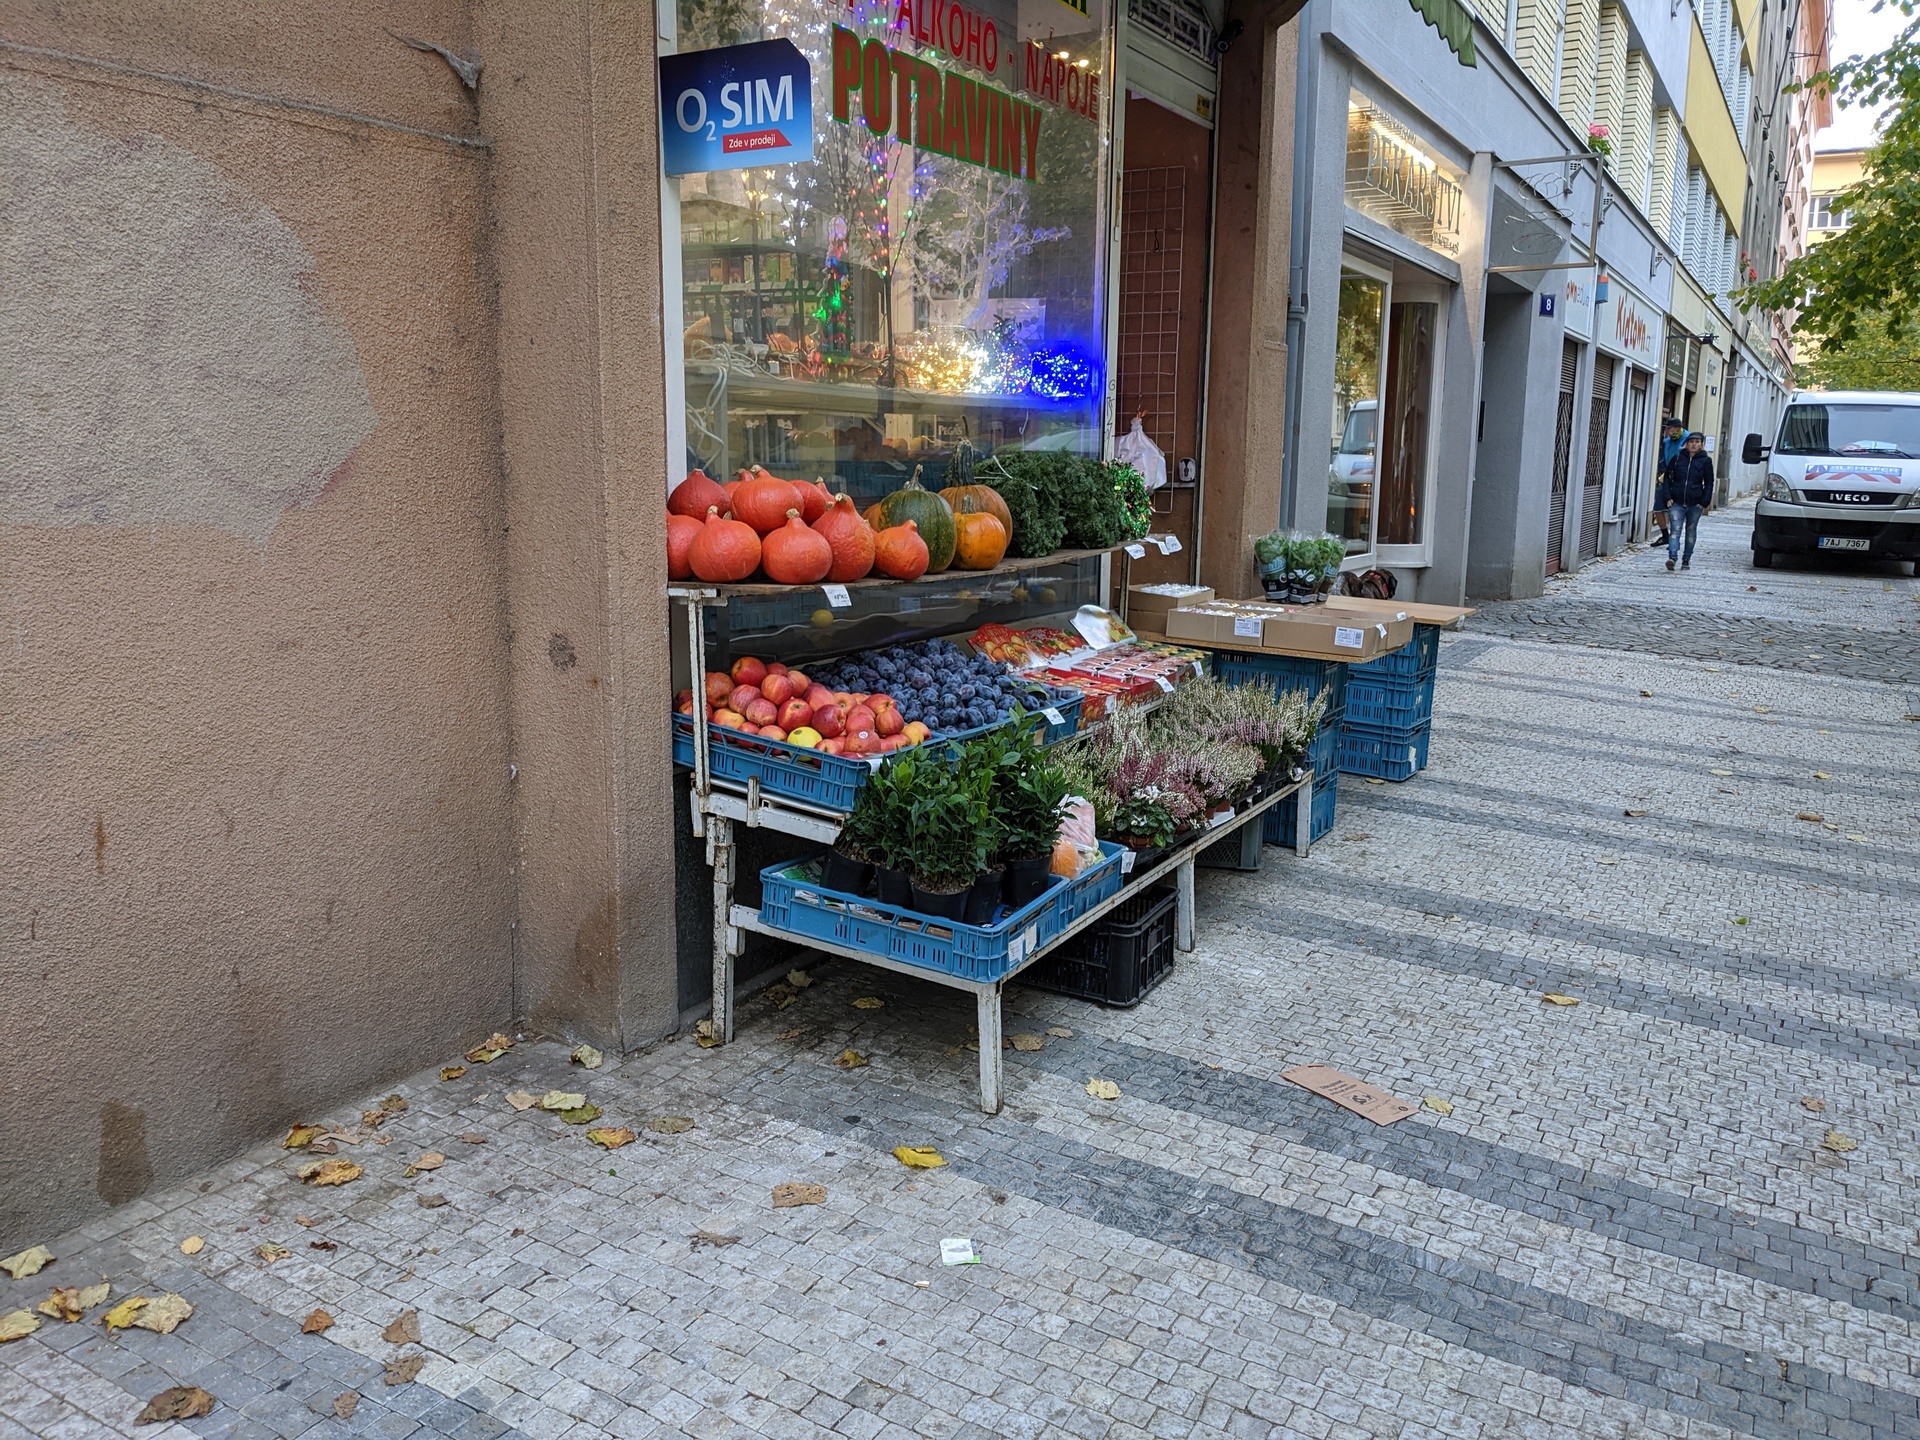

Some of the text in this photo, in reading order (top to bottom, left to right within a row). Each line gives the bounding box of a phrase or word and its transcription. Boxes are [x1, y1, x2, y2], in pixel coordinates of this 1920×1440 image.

[720, 75, 794, 129] SIM
[832, 22, 1043, 184] POTRAVINY
[728, 138, 743, 149] Zde
[750, 134, 776, 148] prodeji
[1545, 298, 1552, 311] 8
[1829, 493, 1870, 502] IVECO
[1825, 538, 1867, 548] 7AJ 7367
